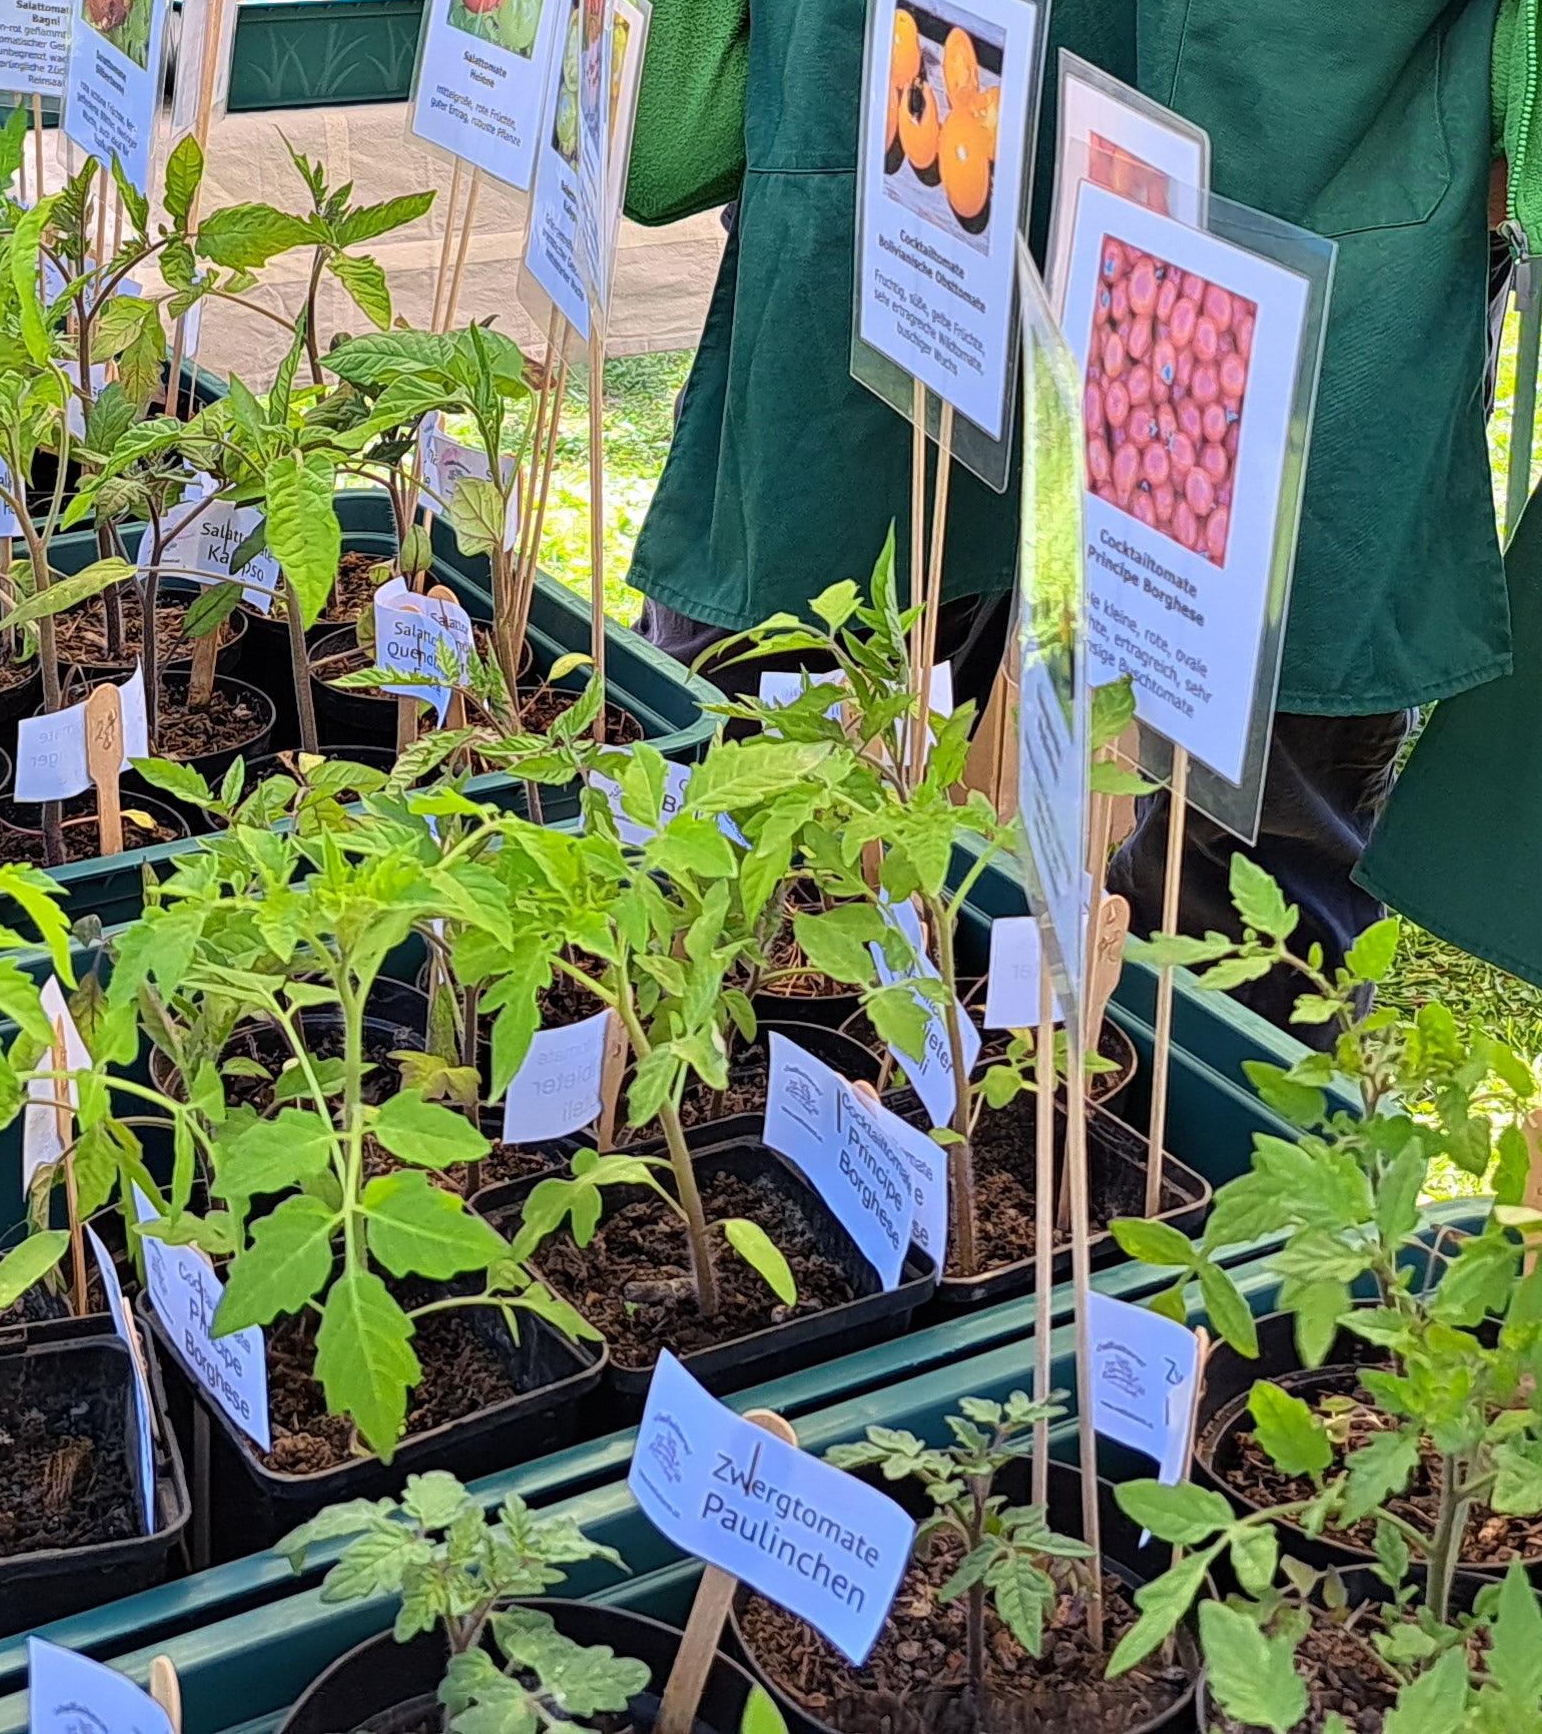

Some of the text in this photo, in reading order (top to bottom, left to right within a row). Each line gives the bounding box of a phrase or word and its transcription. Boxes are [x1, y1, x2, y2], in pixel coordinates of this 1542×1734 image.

[877, 232, 986, 315] Bolivianische Obsttomate
[899, 228, 966, 281] Cocktailtomate
[931, 308, 954, 332] gelbe
[953, 321, 986, 358] Früchte,
[1086, 543, 1206, 628] Principe Borghese
[1099, 527, 1199, 600] Cocktailtomate
[1103, 598, 1141, 638] kleine,
[1143, 628, 1172, 659] rote,
[1175, 648, 1209, 680] ovale
[1113, 632, 1181, 689] ertragreich,
[1184, 677, 1214, 704] sehr
[838, 1149, 900, 1251] Borghese
[847, 1125, 903, 1213] Principe
[184, 1328, 251, 1422] Borghese
[711, 1451, 881, 1570] Zwergtomate
[701, 1492, 868, 1614] Paulinchen
